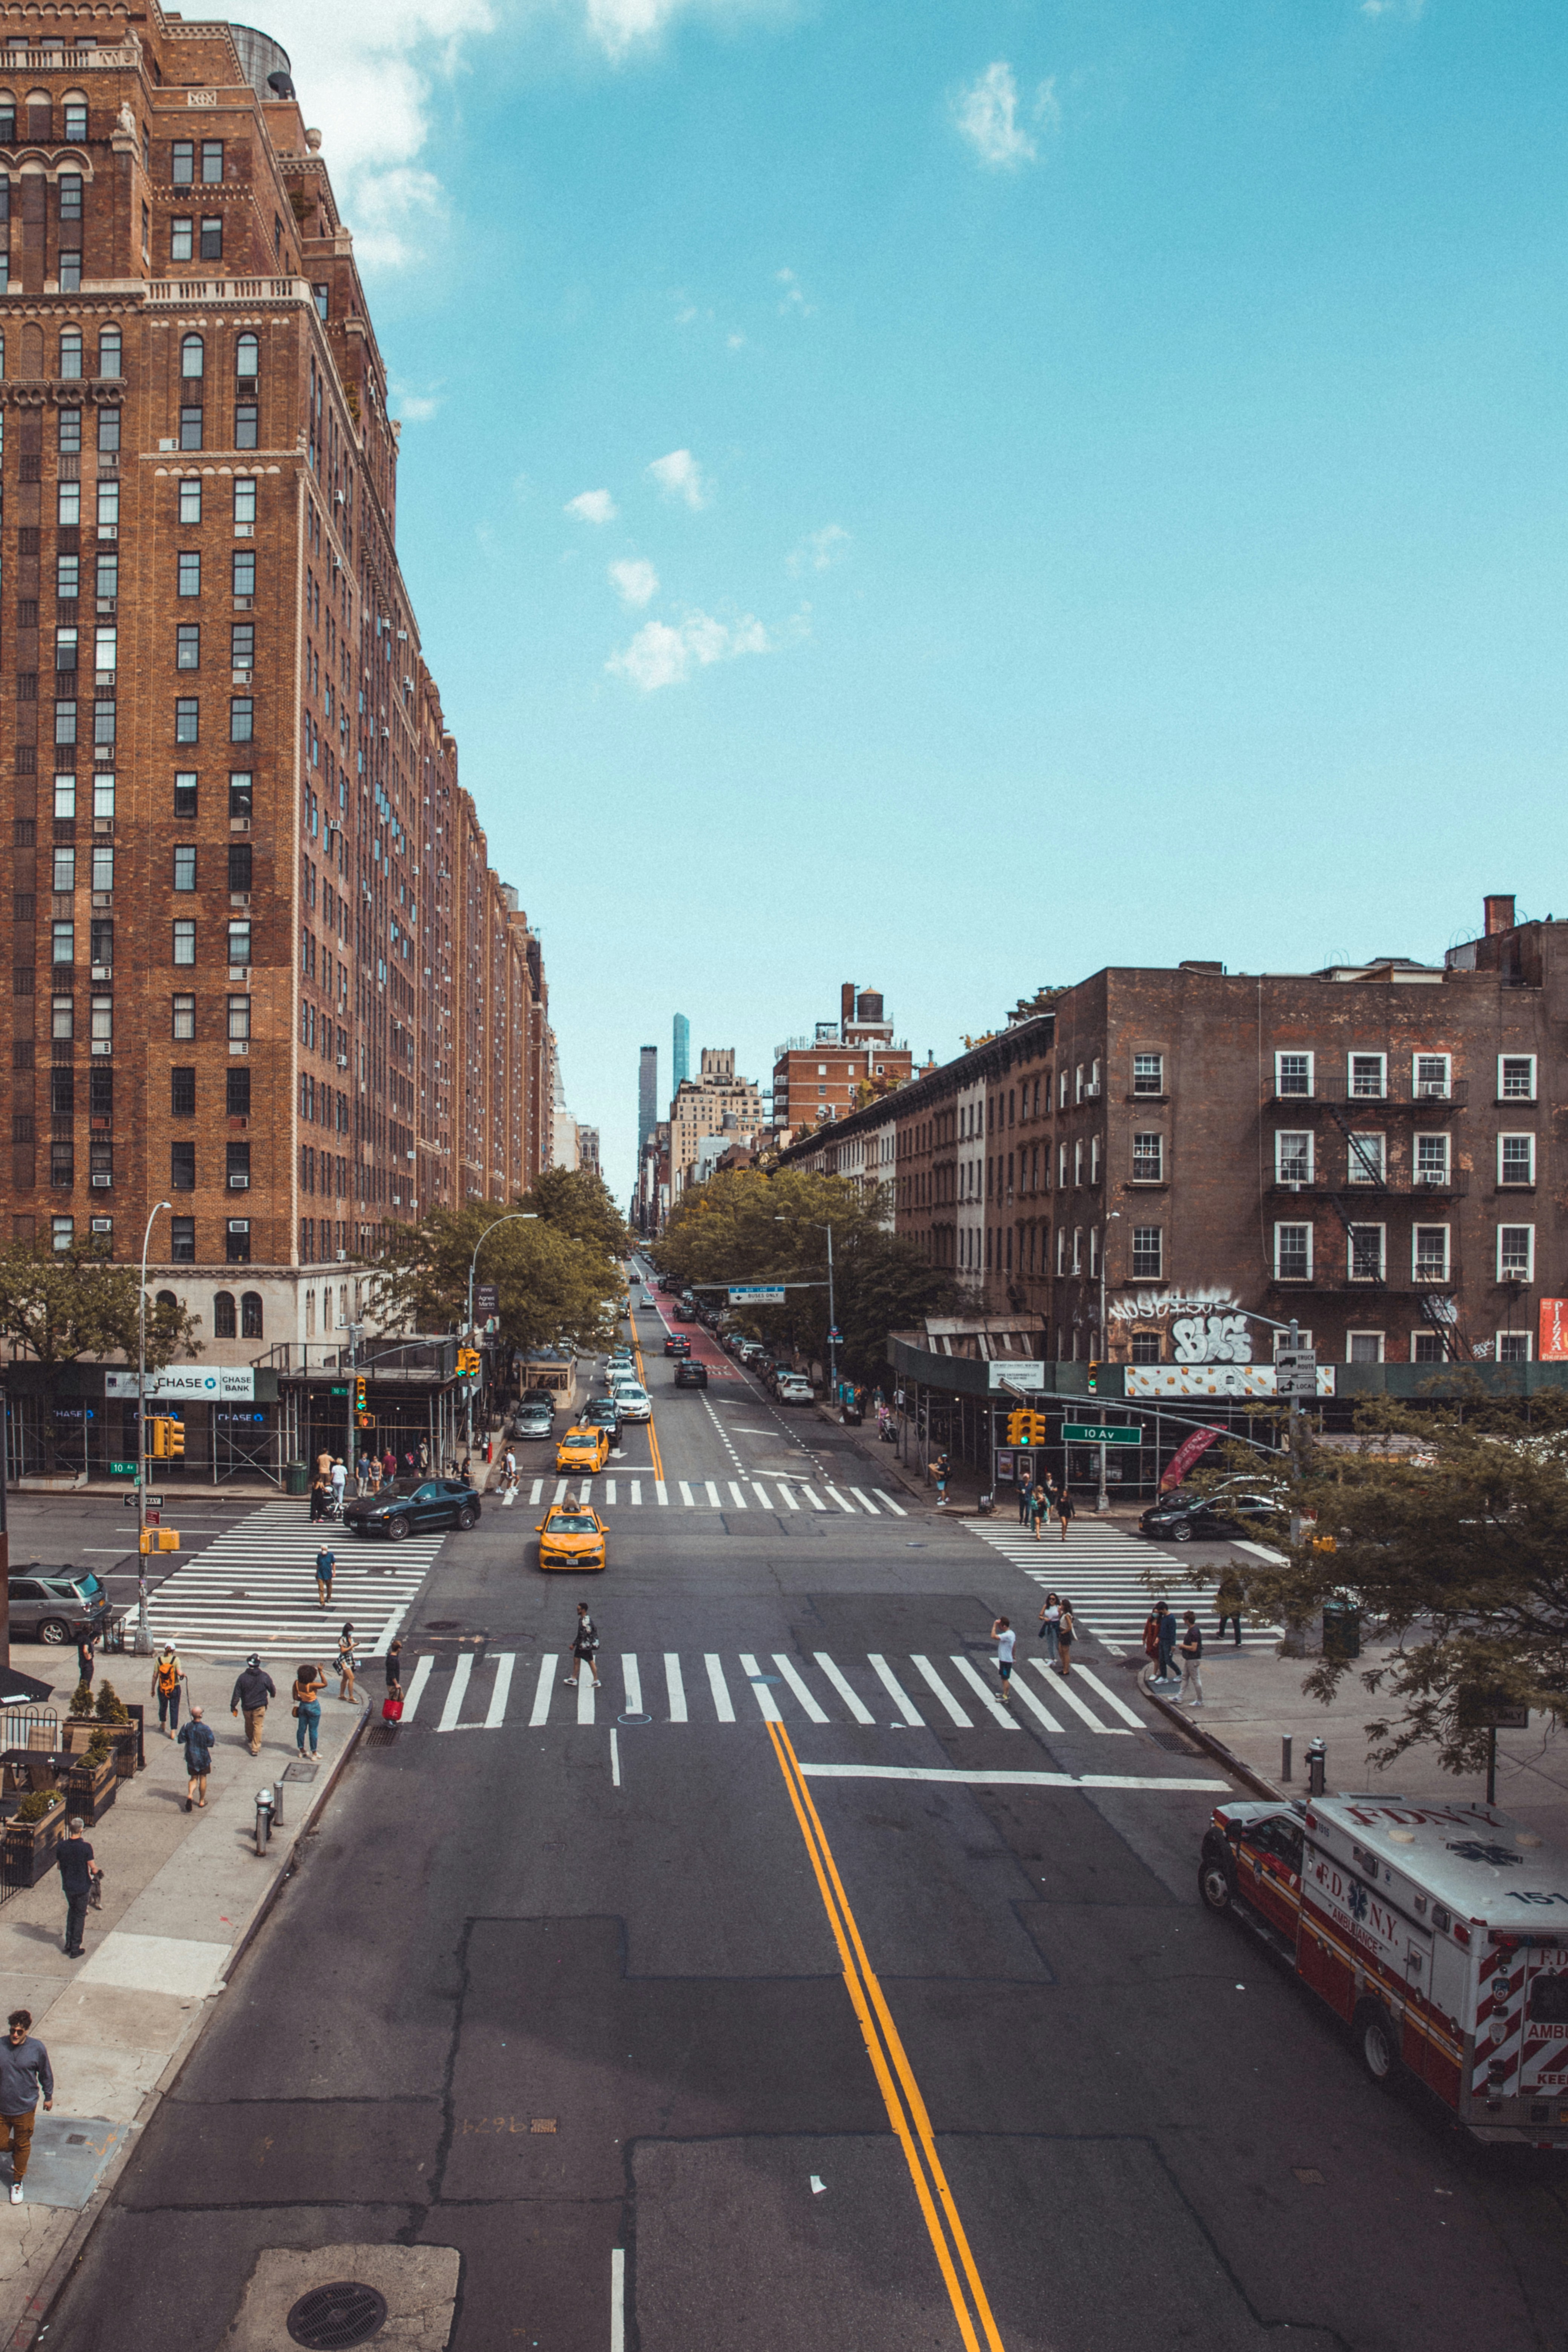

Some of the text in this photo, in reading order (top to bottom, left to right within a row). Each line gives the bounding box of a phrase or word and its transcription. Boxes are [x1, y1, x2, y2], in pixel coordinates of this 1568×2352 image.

[1551, 1301, 1563, 1351] PIZZA
[158, 1378, 202, 1387] CHASE
[1084, 1429, 1114, 1439] 10 Av
[1341, 1807, 1506, 1827] FDNY
[1318, 1823, 1329, 1837] 1515
[1332, 1908, 1378, 1955] AMBULANCE
